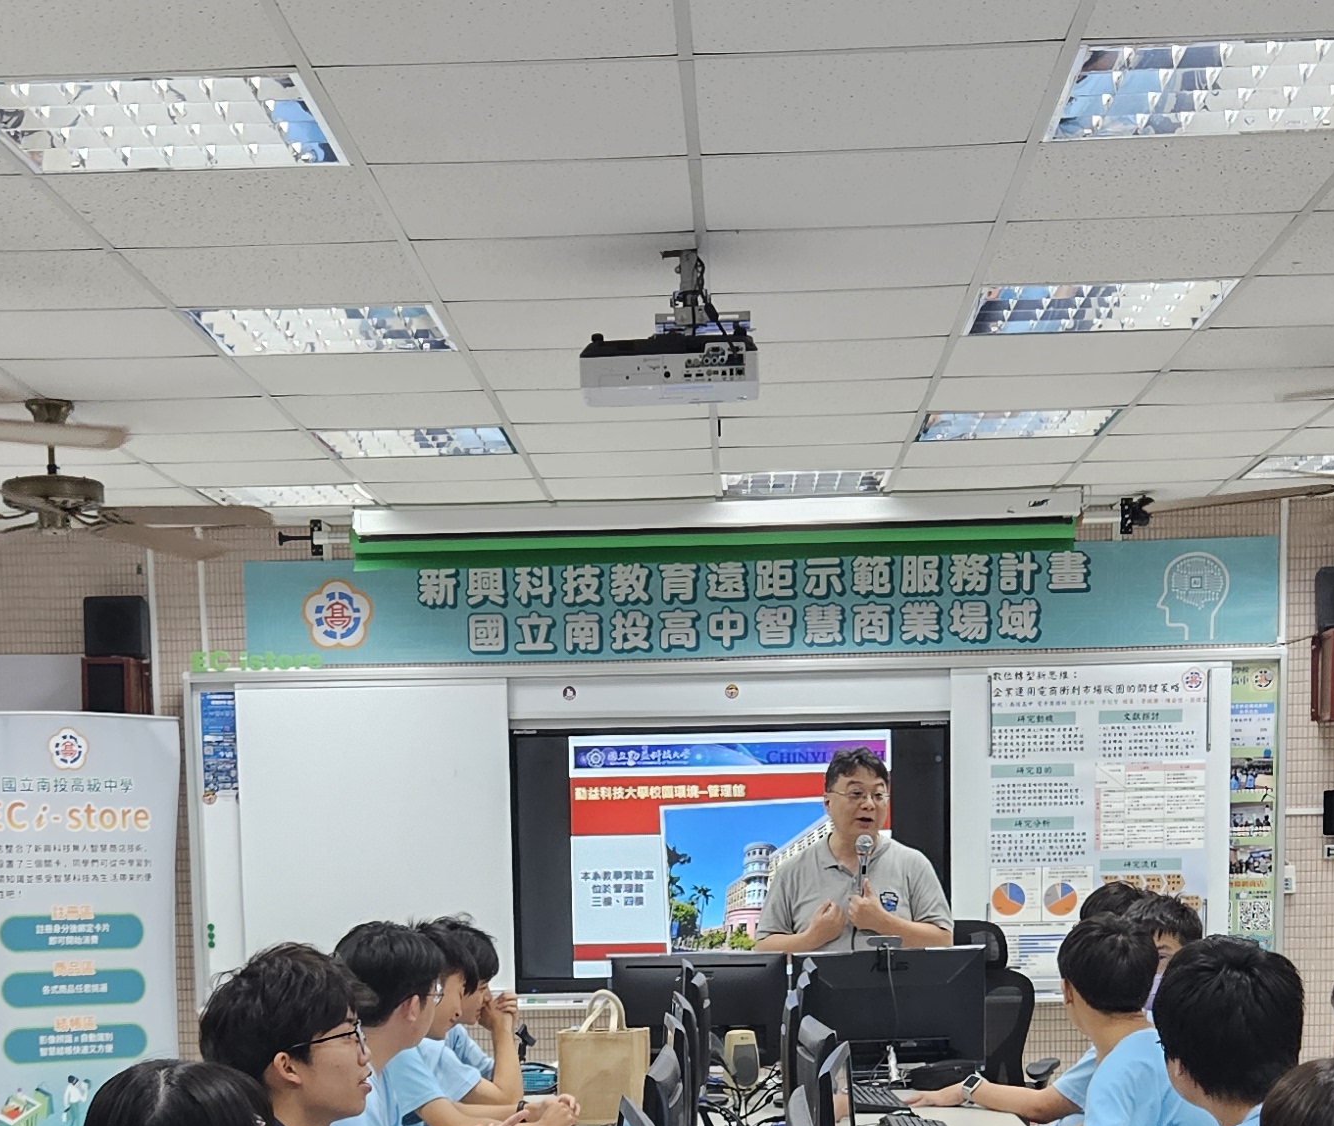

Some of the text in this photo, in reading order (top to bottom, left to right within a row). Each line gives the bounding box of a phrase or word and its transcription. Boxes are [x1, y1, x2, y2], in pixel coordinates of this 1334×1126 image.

[418, 551, 1091, 607] 新興科技教育遠距示範服務計畫
[468, 599, 1042, 654] 國立南投高中智慧商業場域
[191, 650, 323, 672] EC istore
[1, 776, 134, 794] 國立南投高級中學
